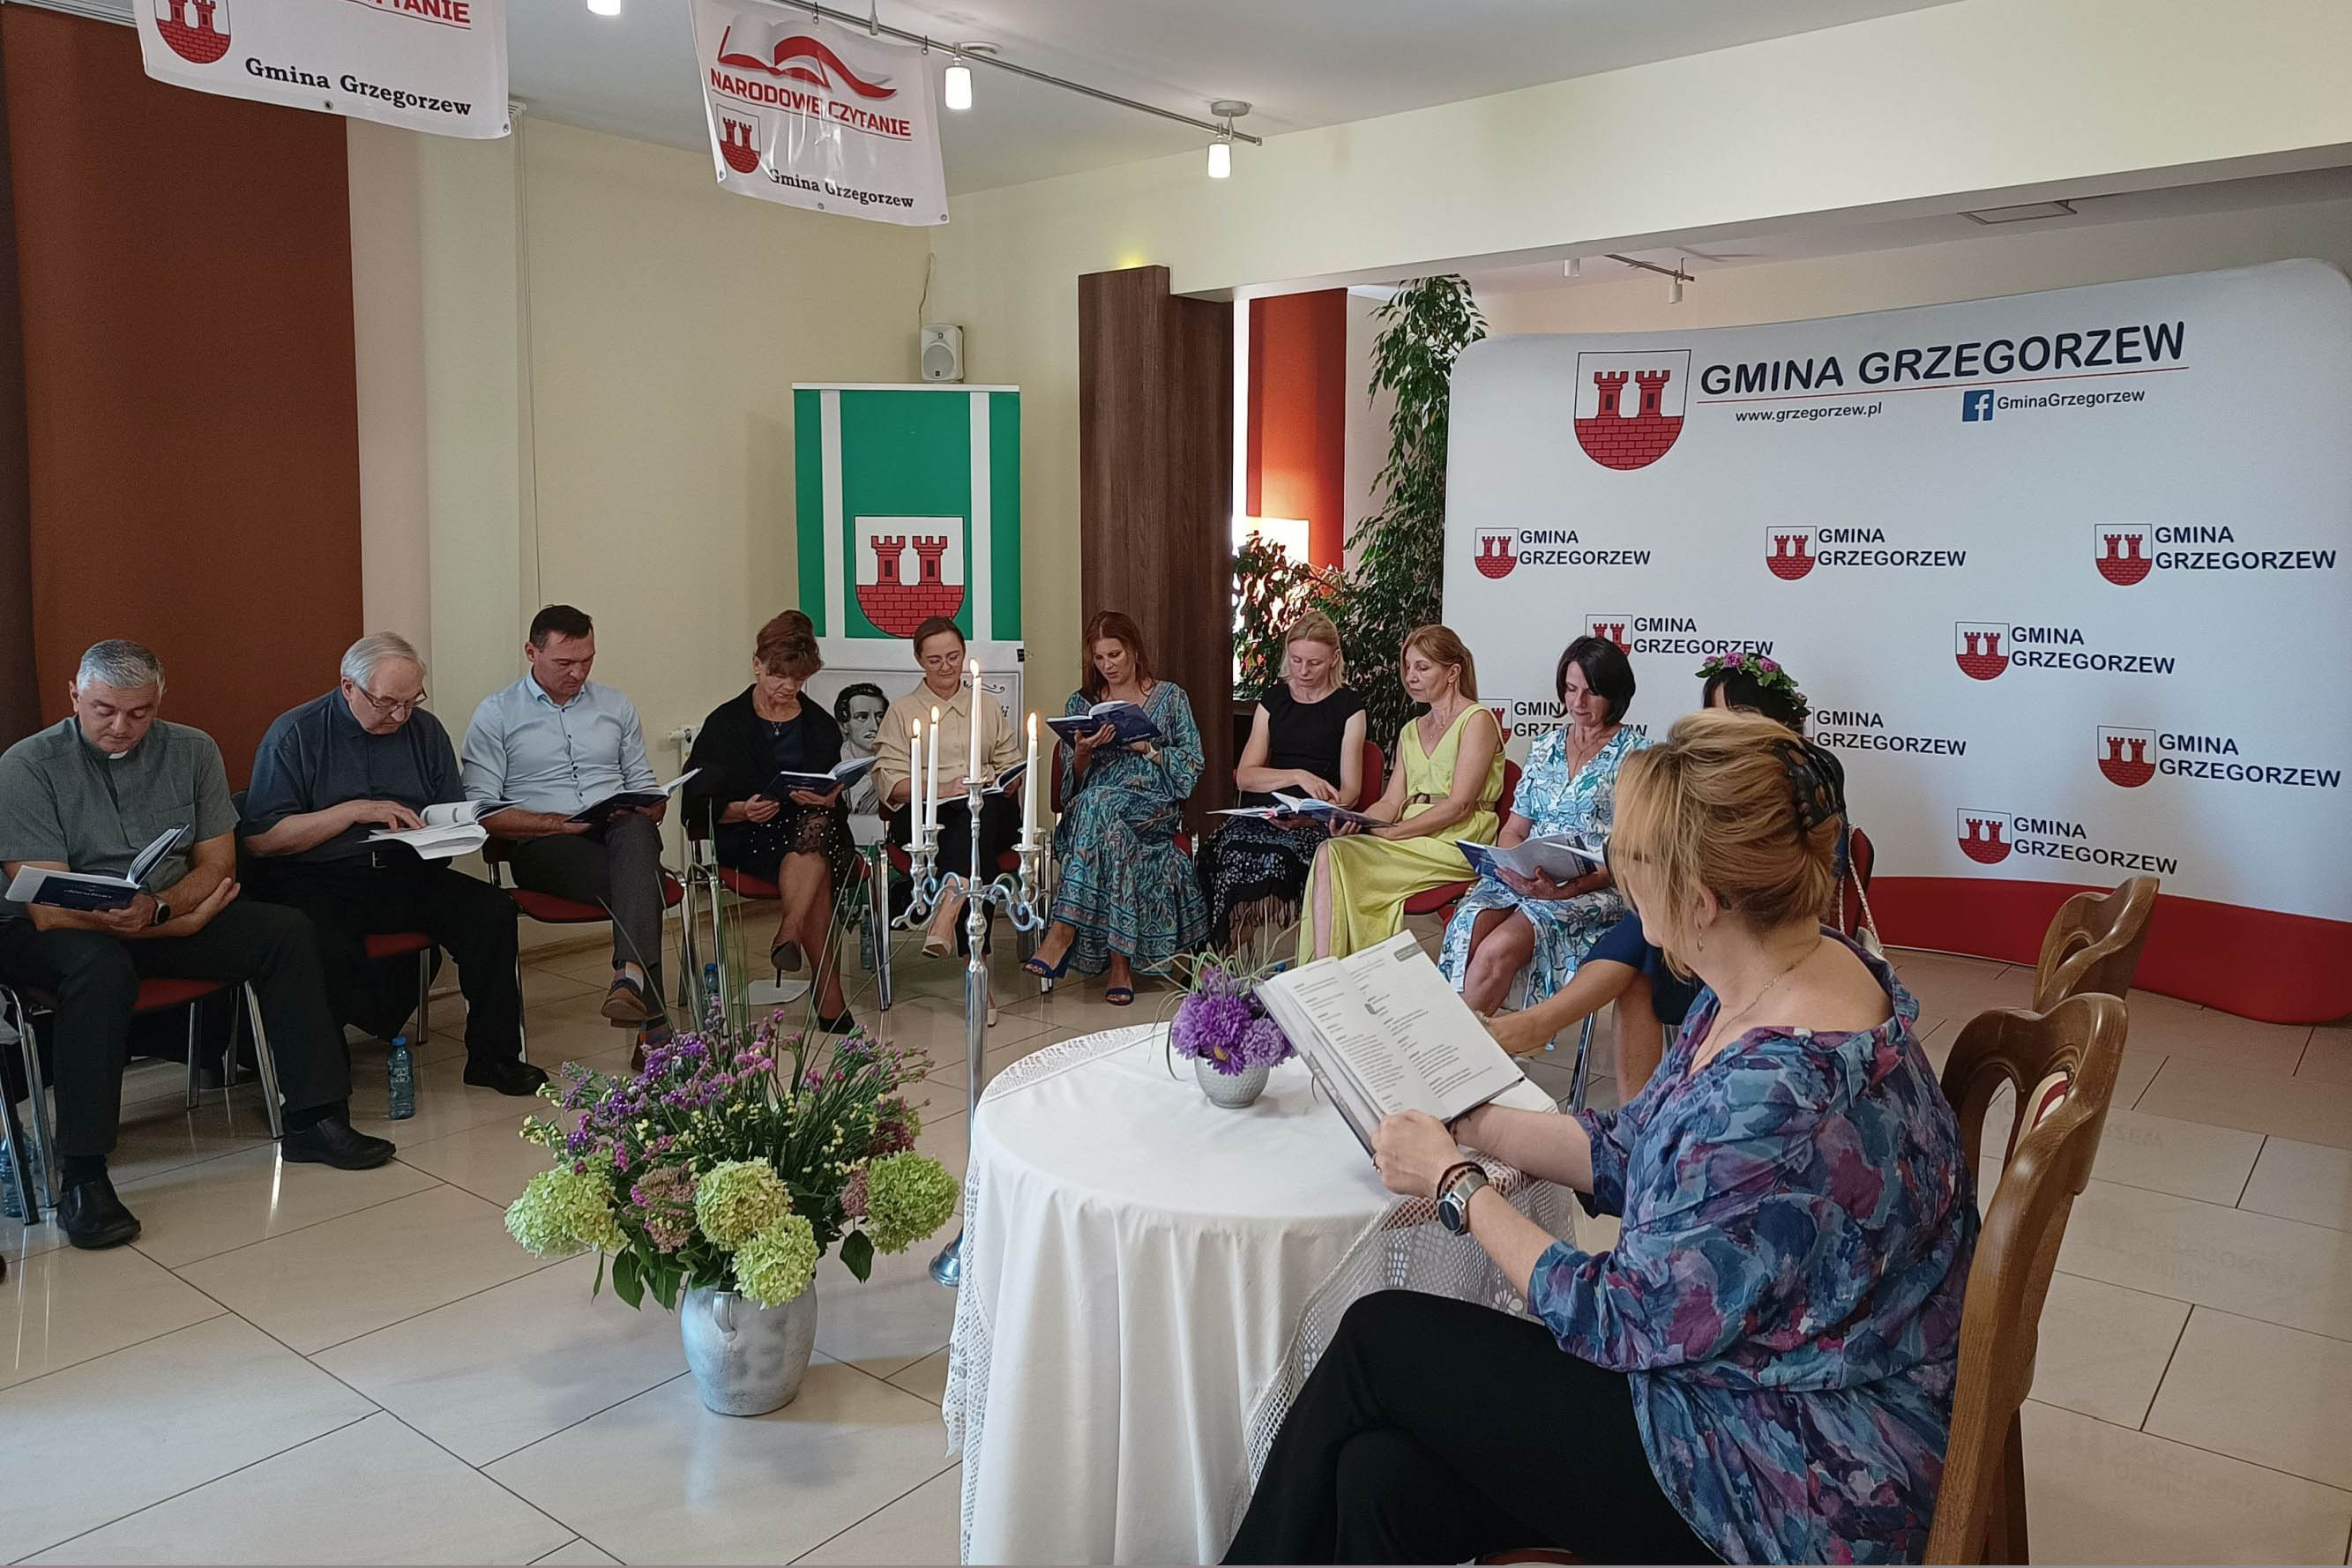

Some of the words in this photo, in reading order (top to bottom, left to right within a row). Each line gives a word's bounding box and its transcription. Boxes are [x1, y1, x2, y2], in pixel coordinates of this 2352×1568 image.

[245, 57, 331, 89] Gmina
[340, 74, 472, 116] Grzegorzew
[711, 68, 824, 115] NARODOWE
[829, 101, 912, 137] CZYTANIE
[769, 168, 821, 192] Gmina
[825, 180, 915, 208] Grzegorzew
[1700, 356, 1844, 395] GMINA
[1858, 321, 2184, 385] GRZEGORZEW
[1997, 390, 2145, 410] GminaGrzegorzew
[1735, 402, 1883, 423] www.grzegorzew.pl
[1519, 530, 1579, 544] GMINA
[1818, 528, 1885, 543] GMINA
[2154, 526, 2235, 544] GMINA
[1519, 550, 1651, 565] GRZEGORZEW
[1818, 550, 1967, 567] GRZEGORZEW
[2155, 550, 2336, 570] GRZEGORZEW
[1633, 617, 1698, 632] GMINA
[2012, 626, 2085, 646] GMINA
[2012, 650, 2176, 675] GRZEGORZEW
[1514, 701, 1561, 716] GMIN
[1816, 710, 1884, 728] GMINA
[1816, 732, 1967, 756] GRZEGORZEW
[2158, 734, 2239, 756] GMINA
[2159, 758, 2341, 788] GRZEGORZEW
[2013, 817, 2087, 840] GMINA
[2013, 839, 2177, 875] GRZEGORZEW
